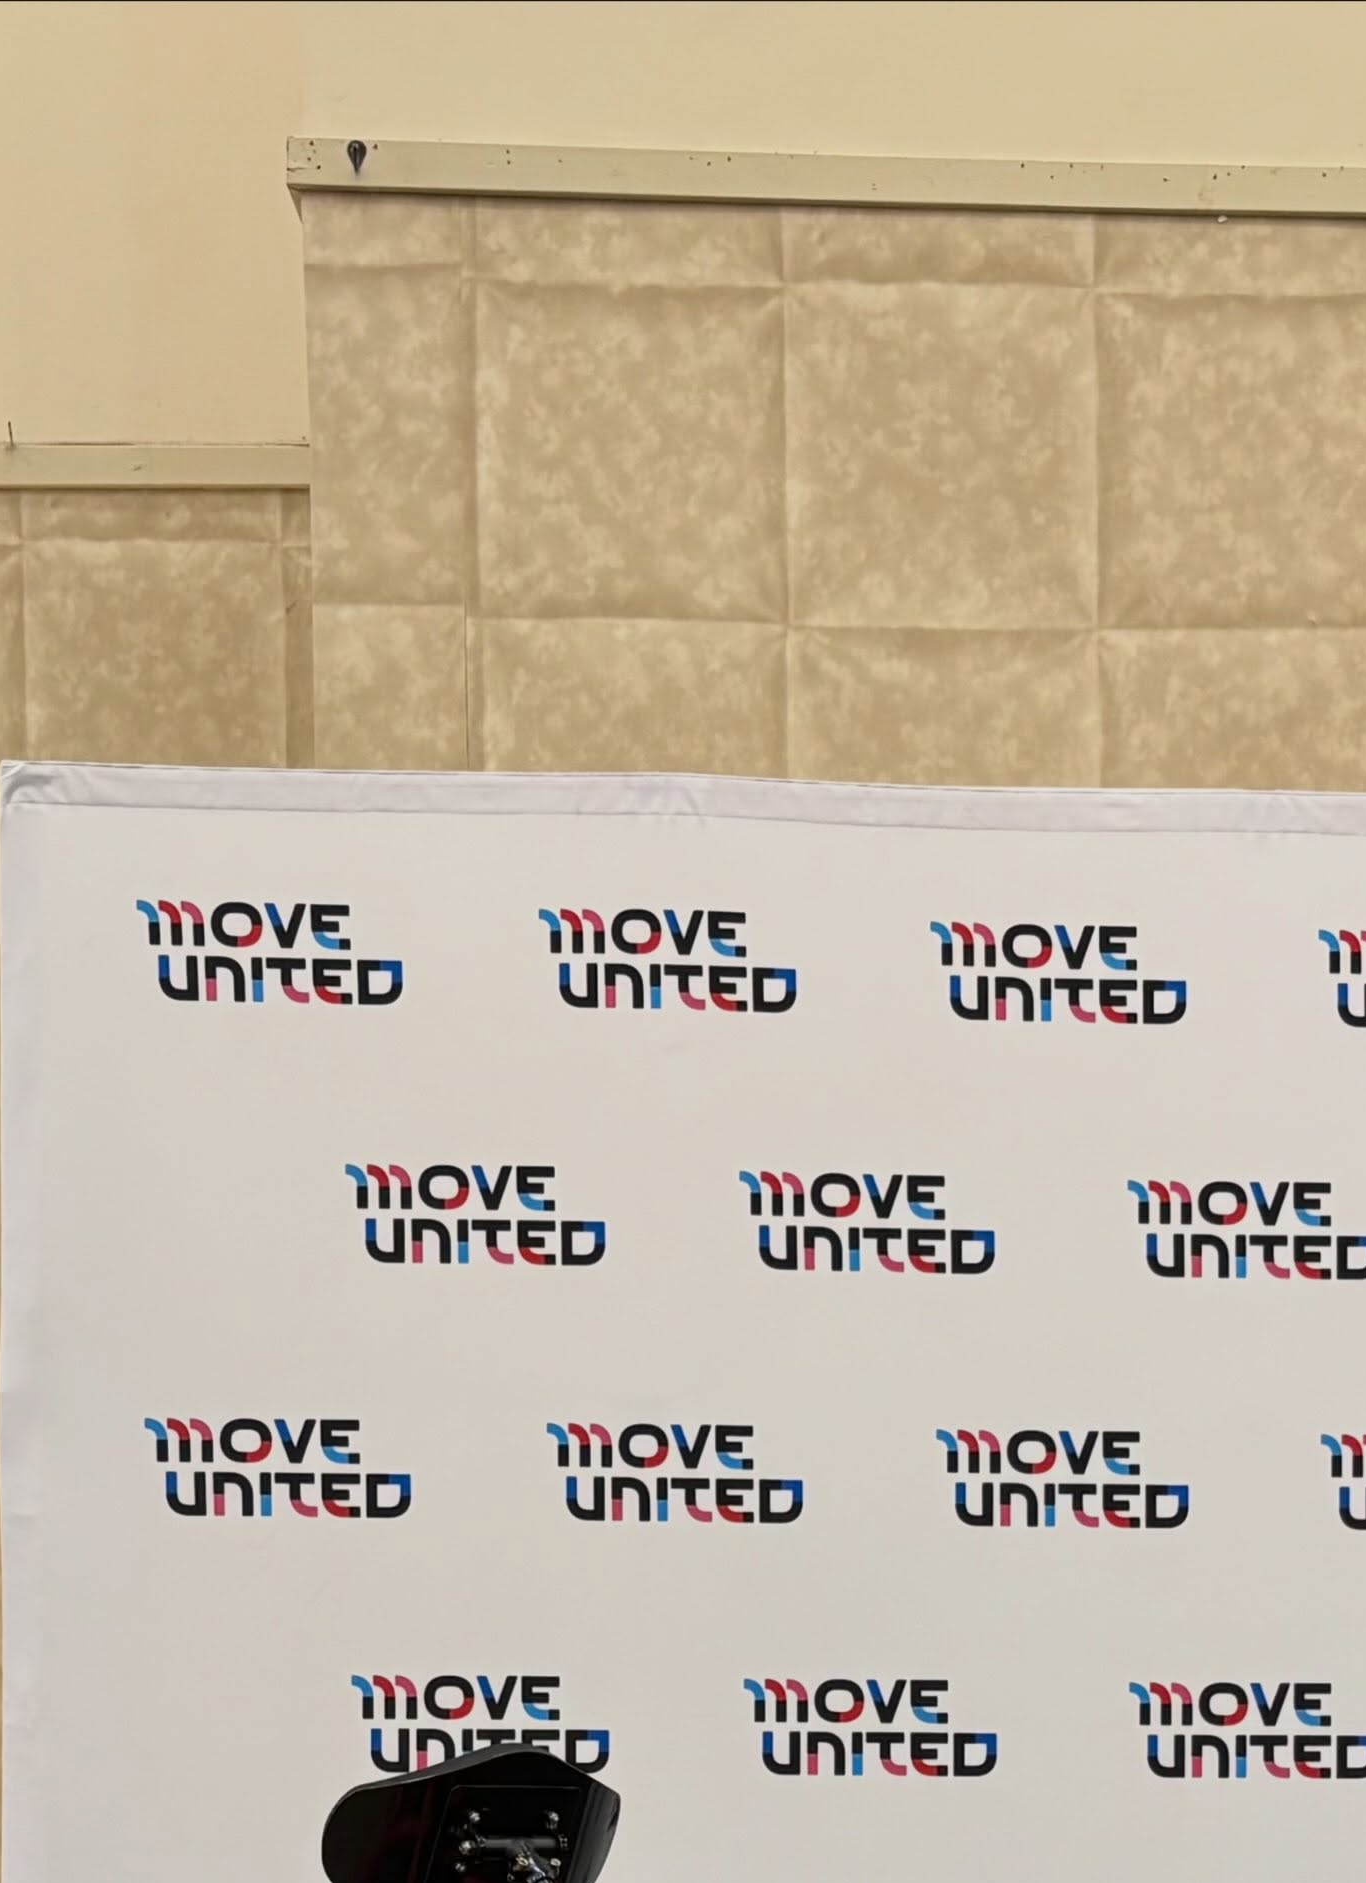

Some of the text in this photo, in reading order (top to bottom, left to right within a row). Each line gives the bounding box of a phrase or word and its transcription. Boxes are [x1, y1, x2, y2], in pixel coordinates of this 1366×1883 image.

[136, 900, 352, 950] MOVE
[538, 909, 747, 957] MOVE
[930, 922, 1138, 970] MOVE
[158, 955, 404, 1005] UNITED
[559, 963, 797, 1013] UNITED
[950, 975, 1187, 1024] UNITED
[345, 1164, 556, 1211] MOVE
[739, 1171, 946, 1220] MOVE
[1127, 1181, 1332, 1226] MOVE
[366, 1218, 606, 1265] UNITED
[759, 1225, 996, 1274] UNITED
[144, 1418, 361, 1464] MOVE
[546, 1423, 754, 1470] MOVE
[936, 1430, 1141, 1475] MOVE
[166, 1471, 412, 1518] UNITED
[566, 1476, 804, 1523] UNITED
[955, 1482, 1190, 1528] UNITED
[351, 1675, 561, 1720] MOVE
[743, 1679, 949, 1724] MOVE
[1129, 1683, 1332, 1726] MOVE
[762, 1731, 998, 1776] UNITED
